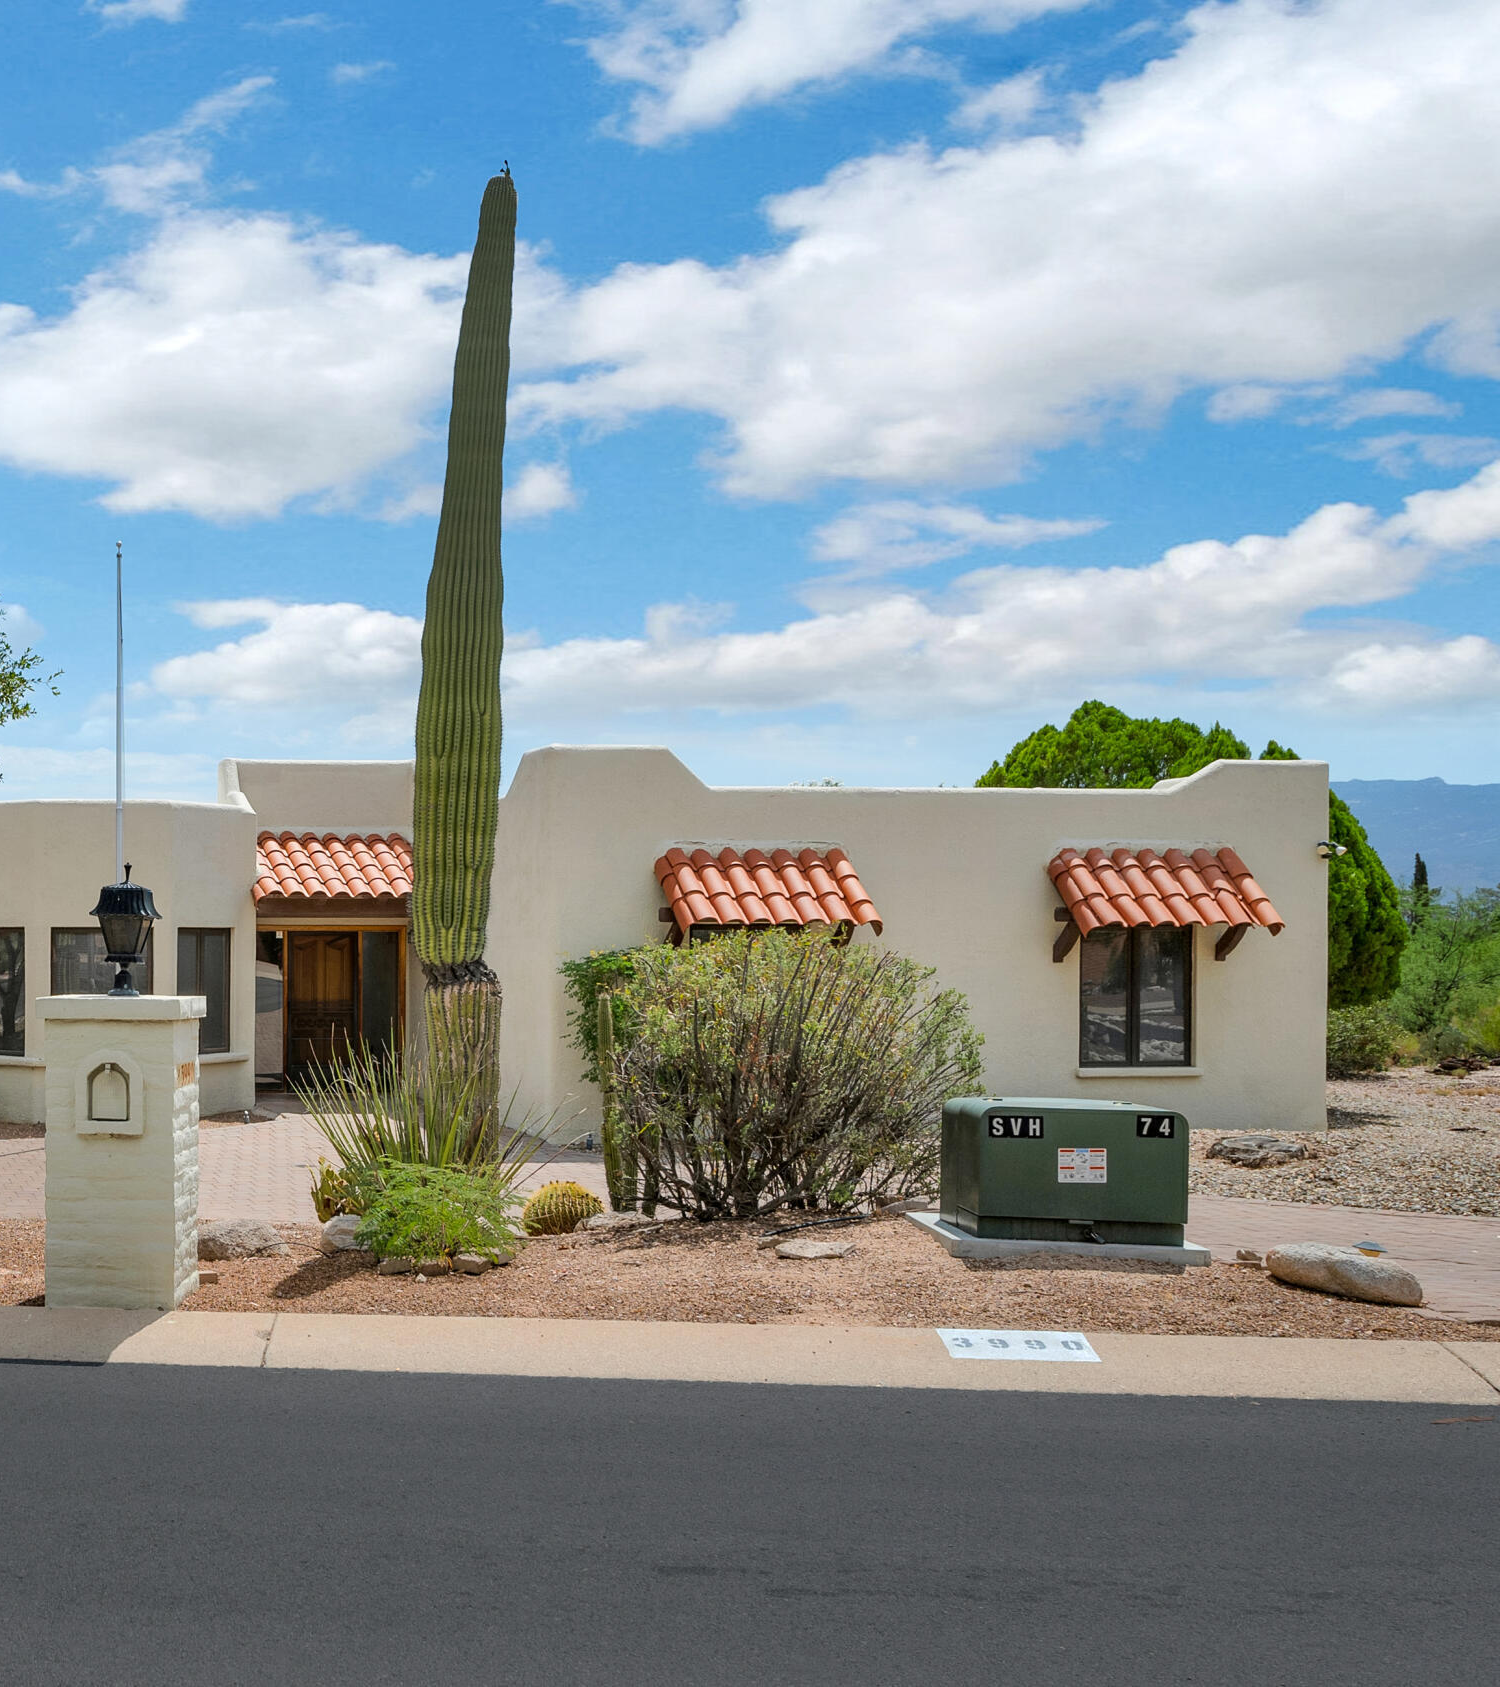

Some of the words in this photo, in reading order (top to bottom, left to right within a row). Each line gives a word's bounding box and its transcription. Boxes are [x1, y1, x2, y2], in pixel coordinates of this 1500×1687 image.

[992, 1118, 1041, 1137] SVH
[1141, 1118, 1171, 1136] 74
[952, 1337, 1084, 1351] 3990
